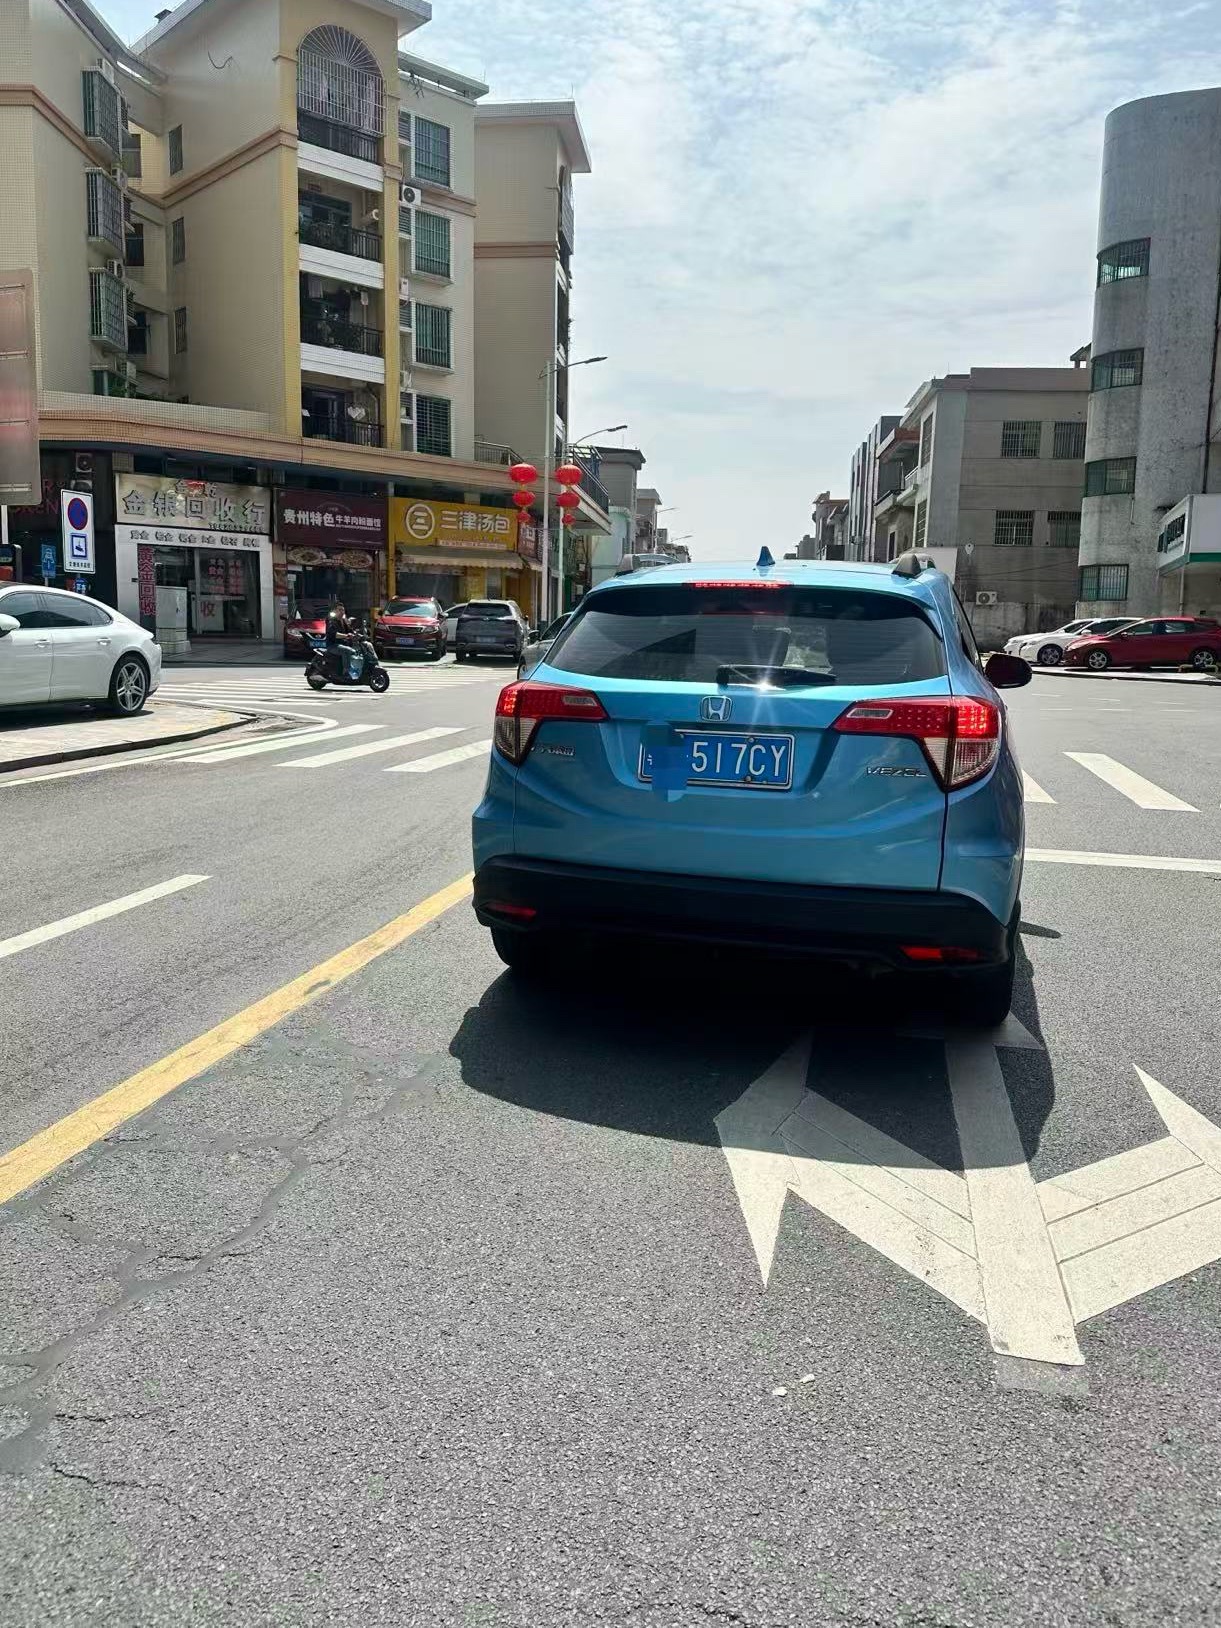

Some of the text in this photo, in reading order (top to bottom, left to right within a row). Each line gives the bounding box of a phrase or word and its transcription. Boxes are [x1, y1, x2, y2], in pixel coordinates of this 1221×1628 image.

[122, 489, 265, 526] 金银回收行
[283, 508, 335, 527] 贵州特色
[441, 510, 510, 534] 三津汤包
[138, 546, 157, 616] 黄金回收
[691, 741, 786, 777] 517CY
[865, 766, 928, 778] VEZEL
